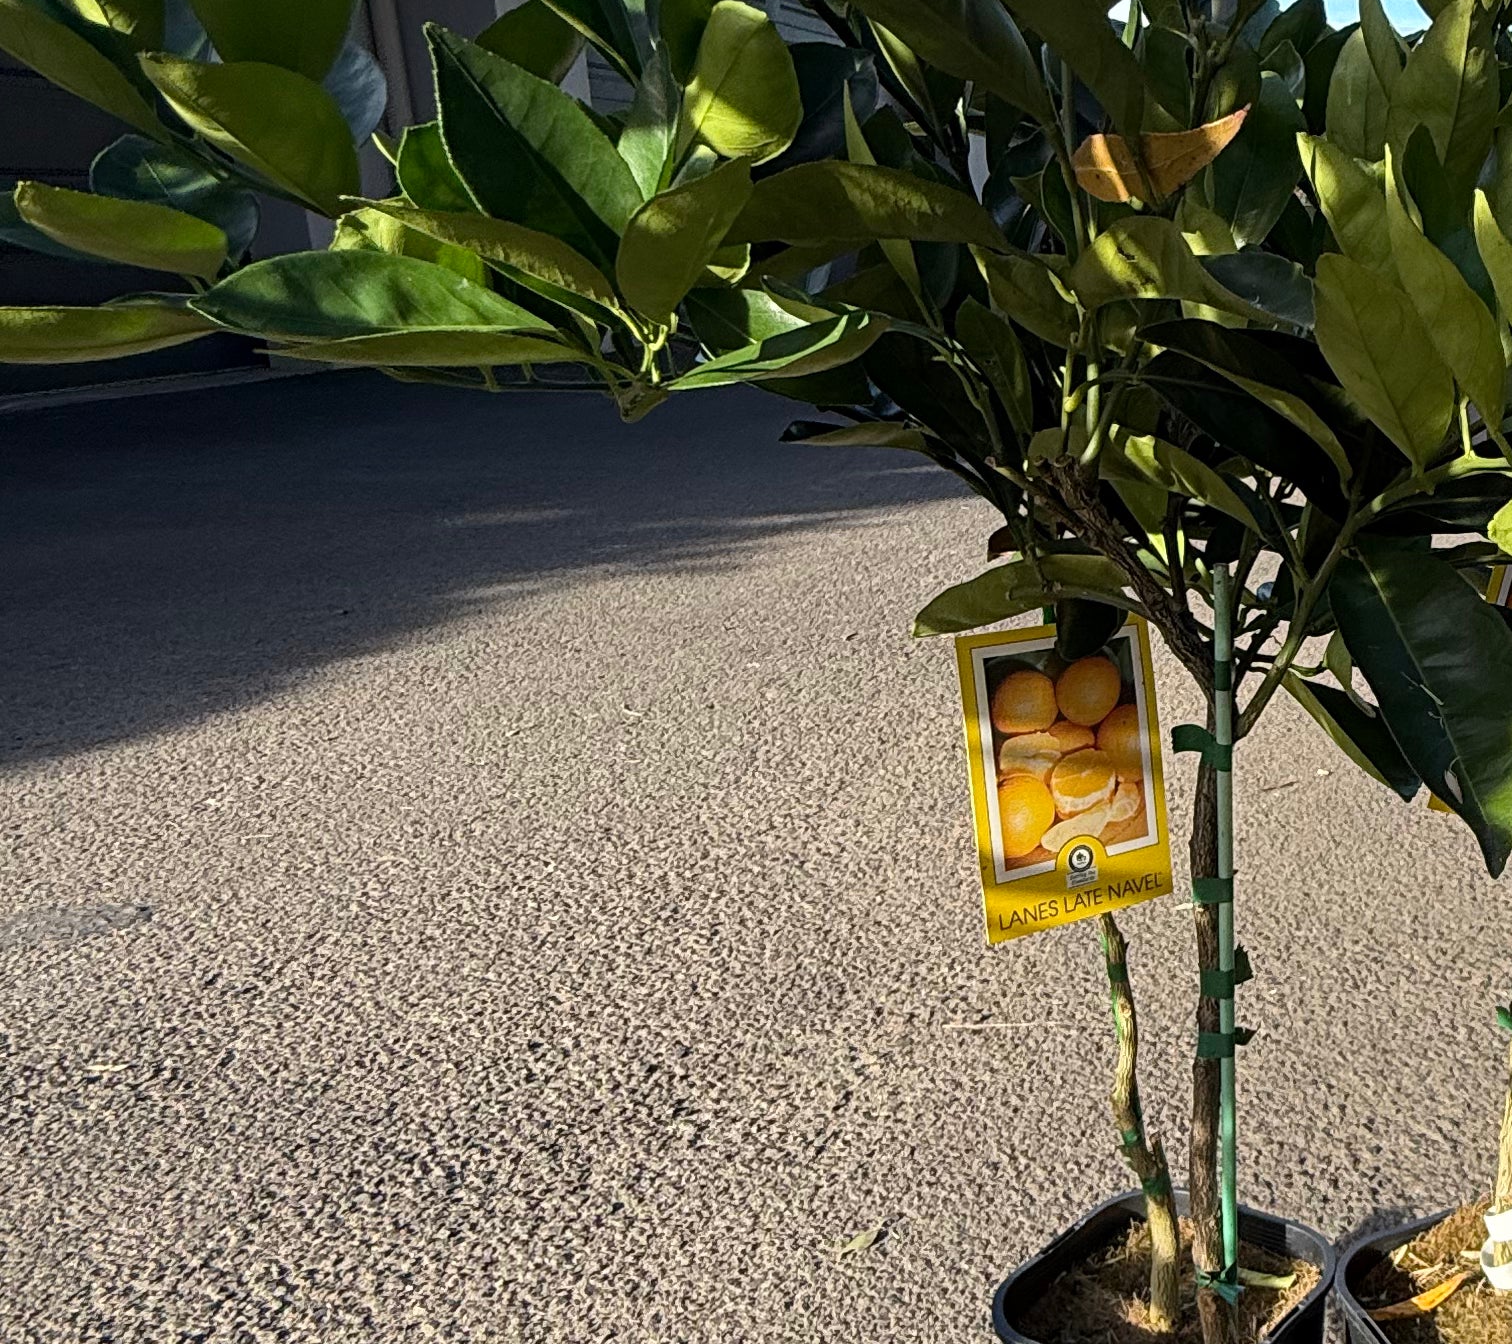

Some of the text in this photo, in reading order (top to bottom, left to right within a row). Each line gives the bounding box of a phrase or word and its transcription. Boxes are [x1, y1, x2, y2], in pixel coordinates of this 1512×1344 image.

[999, 899, 1059, 931] LANES
[1063, 887, 1102, 914] LATE
[1108, 872, 1163, 902] NAVEL
